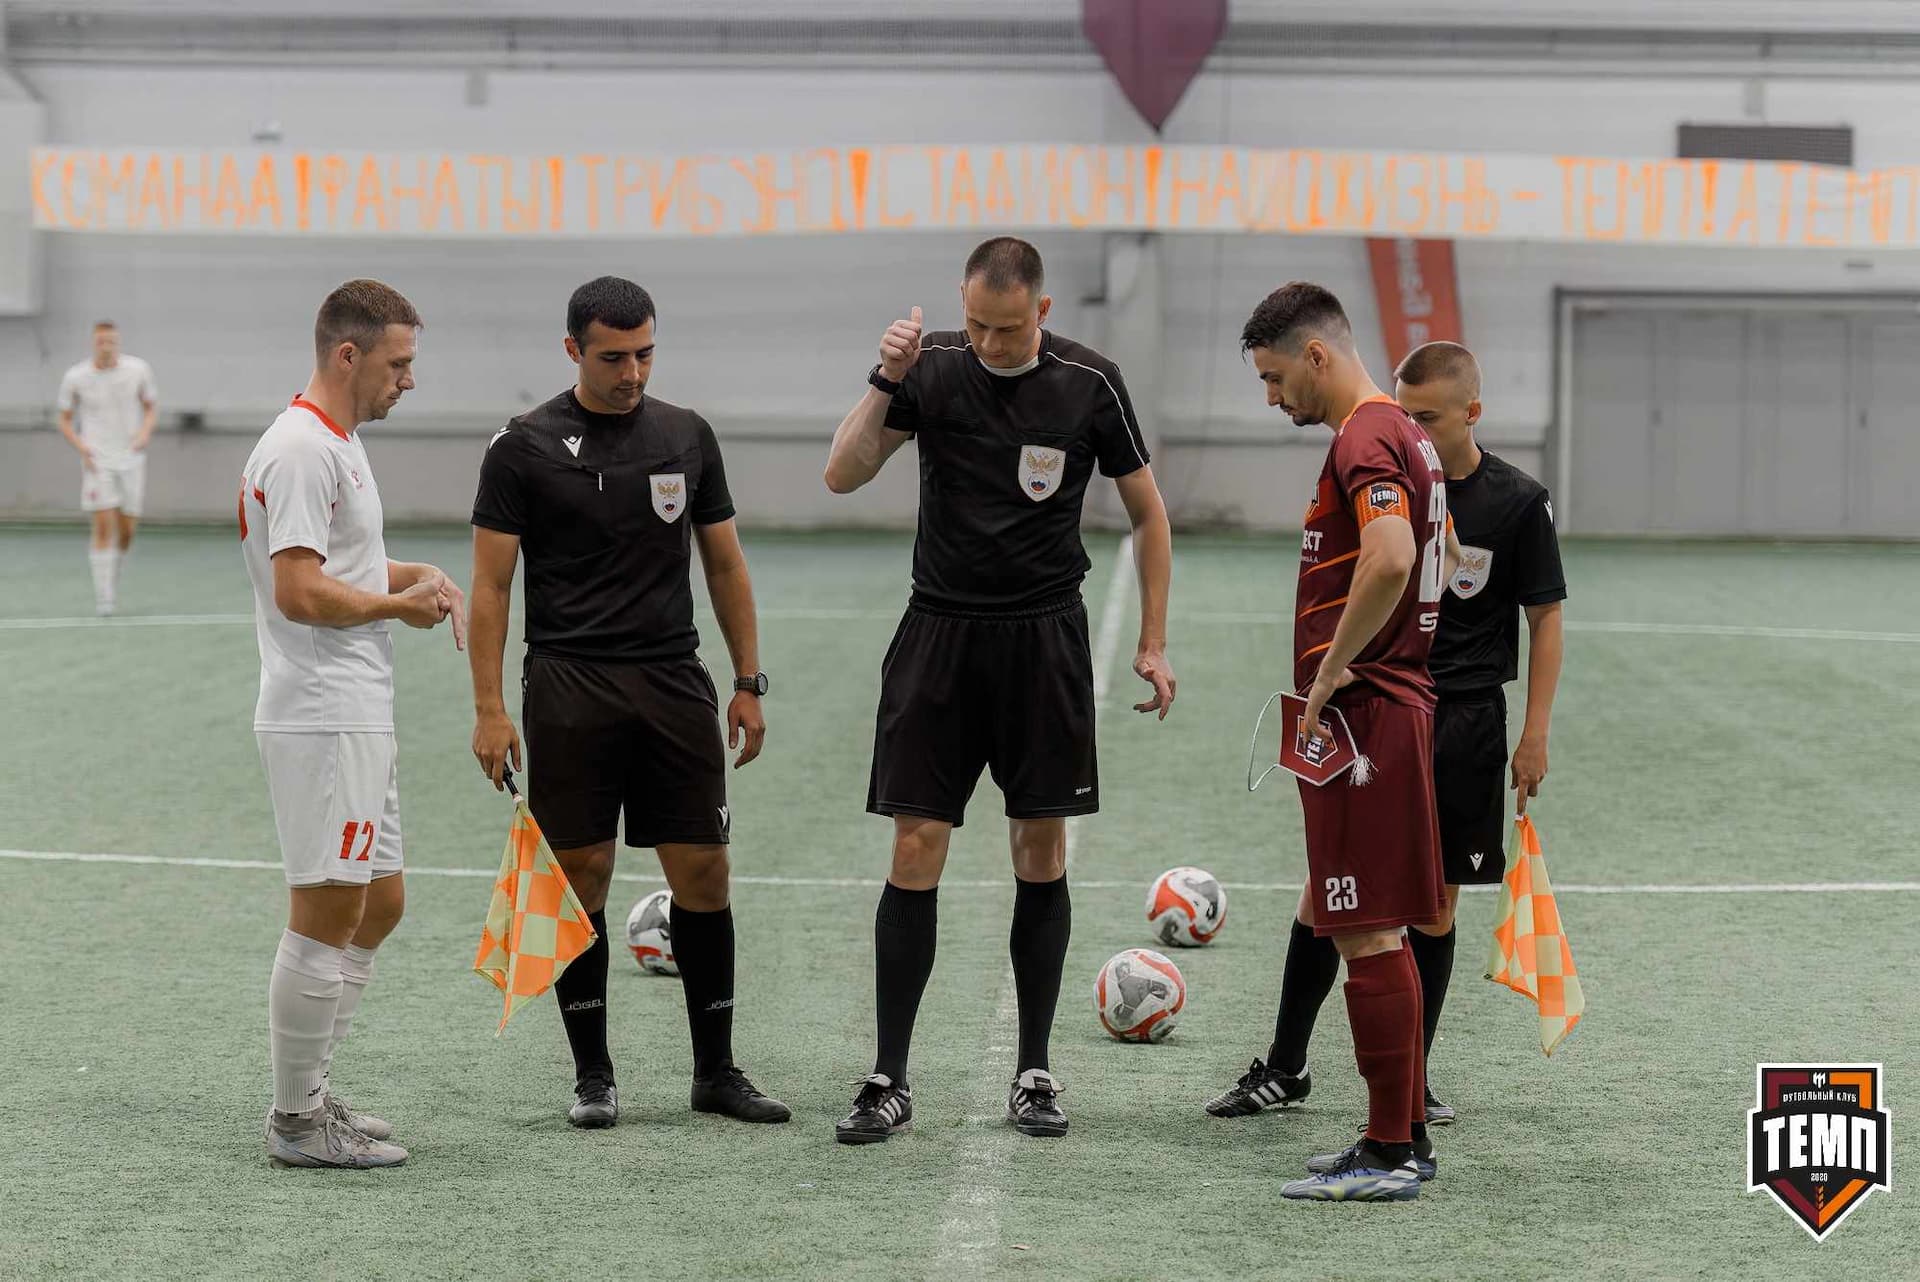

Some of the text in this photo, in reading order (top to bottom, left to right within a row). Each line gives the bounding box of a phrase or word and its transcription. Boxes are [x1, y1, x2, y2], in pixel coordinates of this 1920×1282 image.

[1370, 490, 1398, 504] ТЕМП
[339, 820, 375, 861] 12
[1325, 876, 1359, 912] 23
